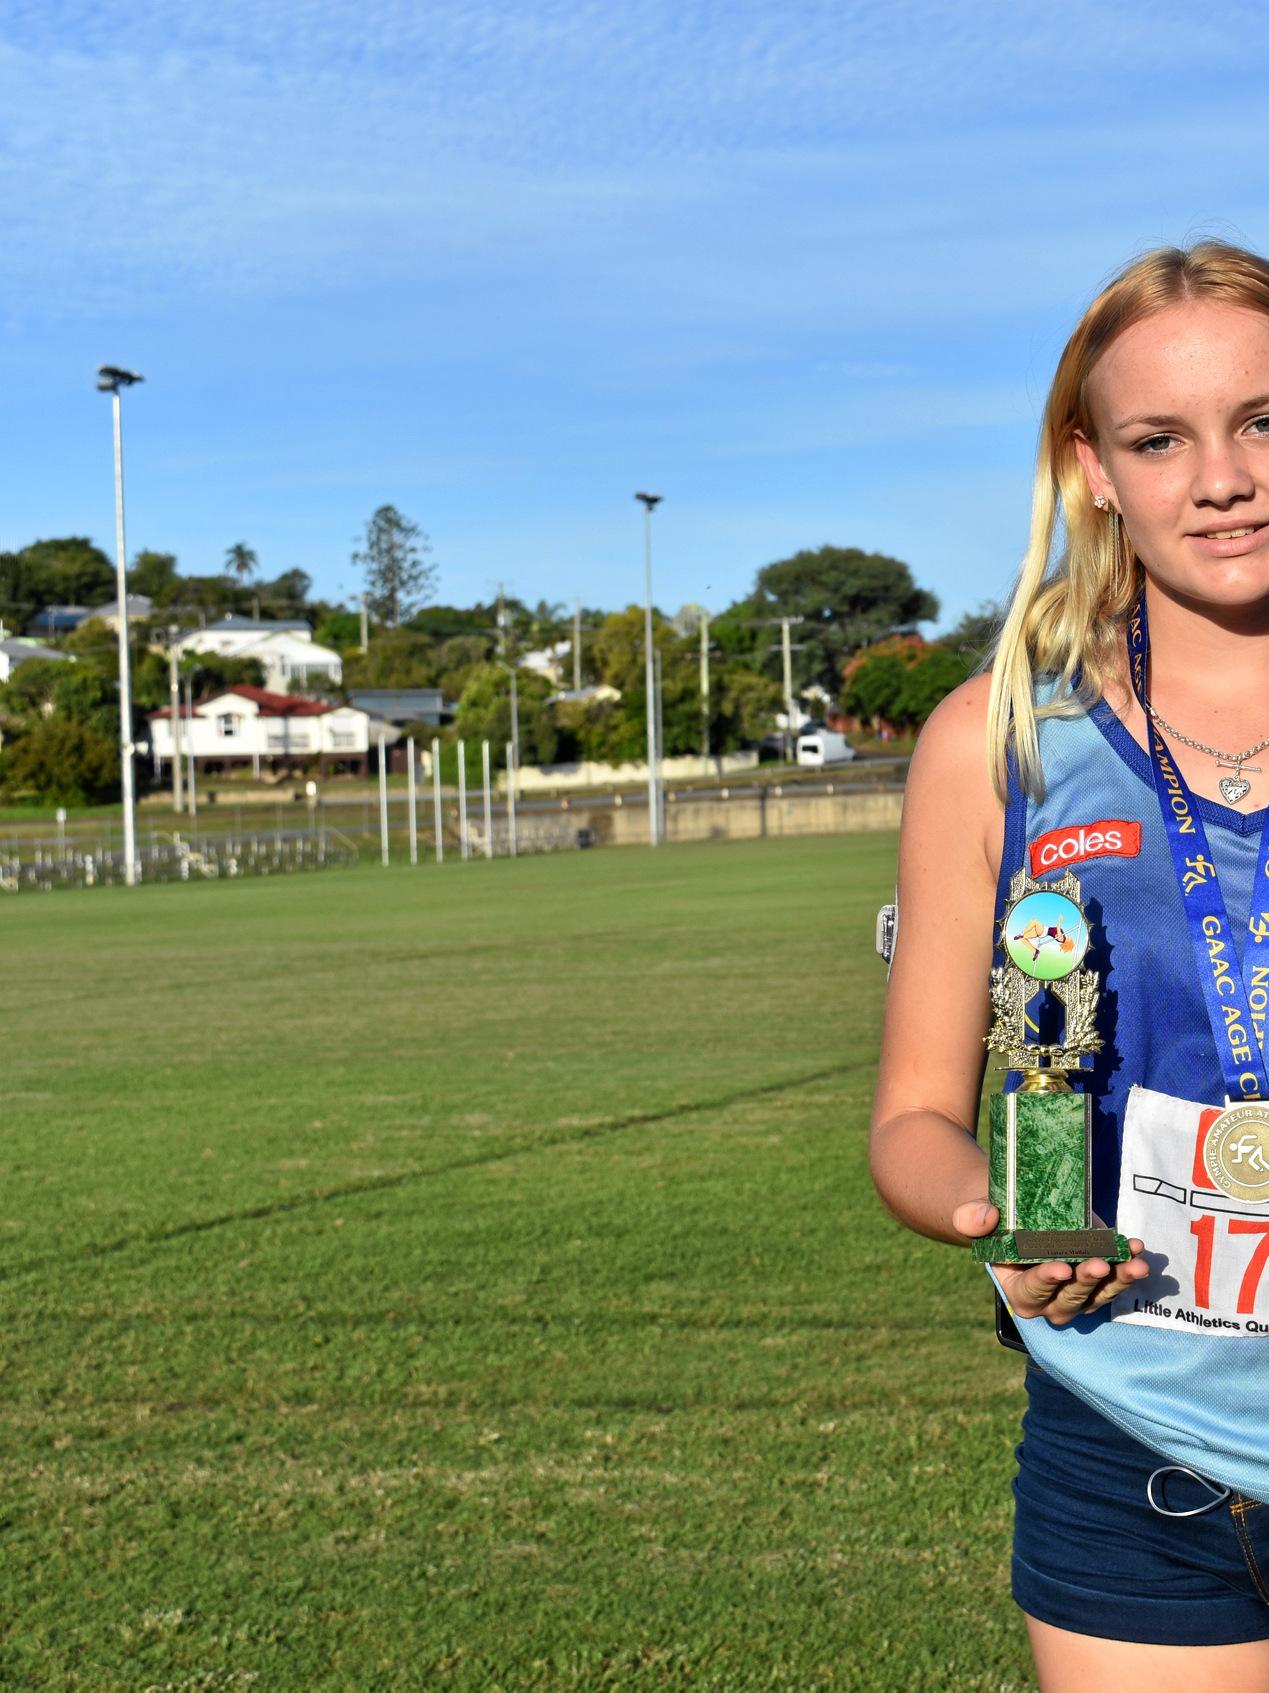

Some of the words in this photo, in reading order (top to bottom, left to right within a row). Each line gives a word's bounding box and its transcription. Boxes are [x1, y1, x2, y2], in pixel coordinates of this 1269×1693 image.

[1040, 829, 1122, 865] coles
[1202, 915, 1235, 996] GAAC
[1221, 1005, 1252, 1065] AGE
[1211, 1110, 1253, 1146] AMATEUR
[1209, 1148, 1232, 1189] GYMPIE
[1134, 1298, 1172, 1318] Little
[1175, 1308, 1240, 1331] Athletics
